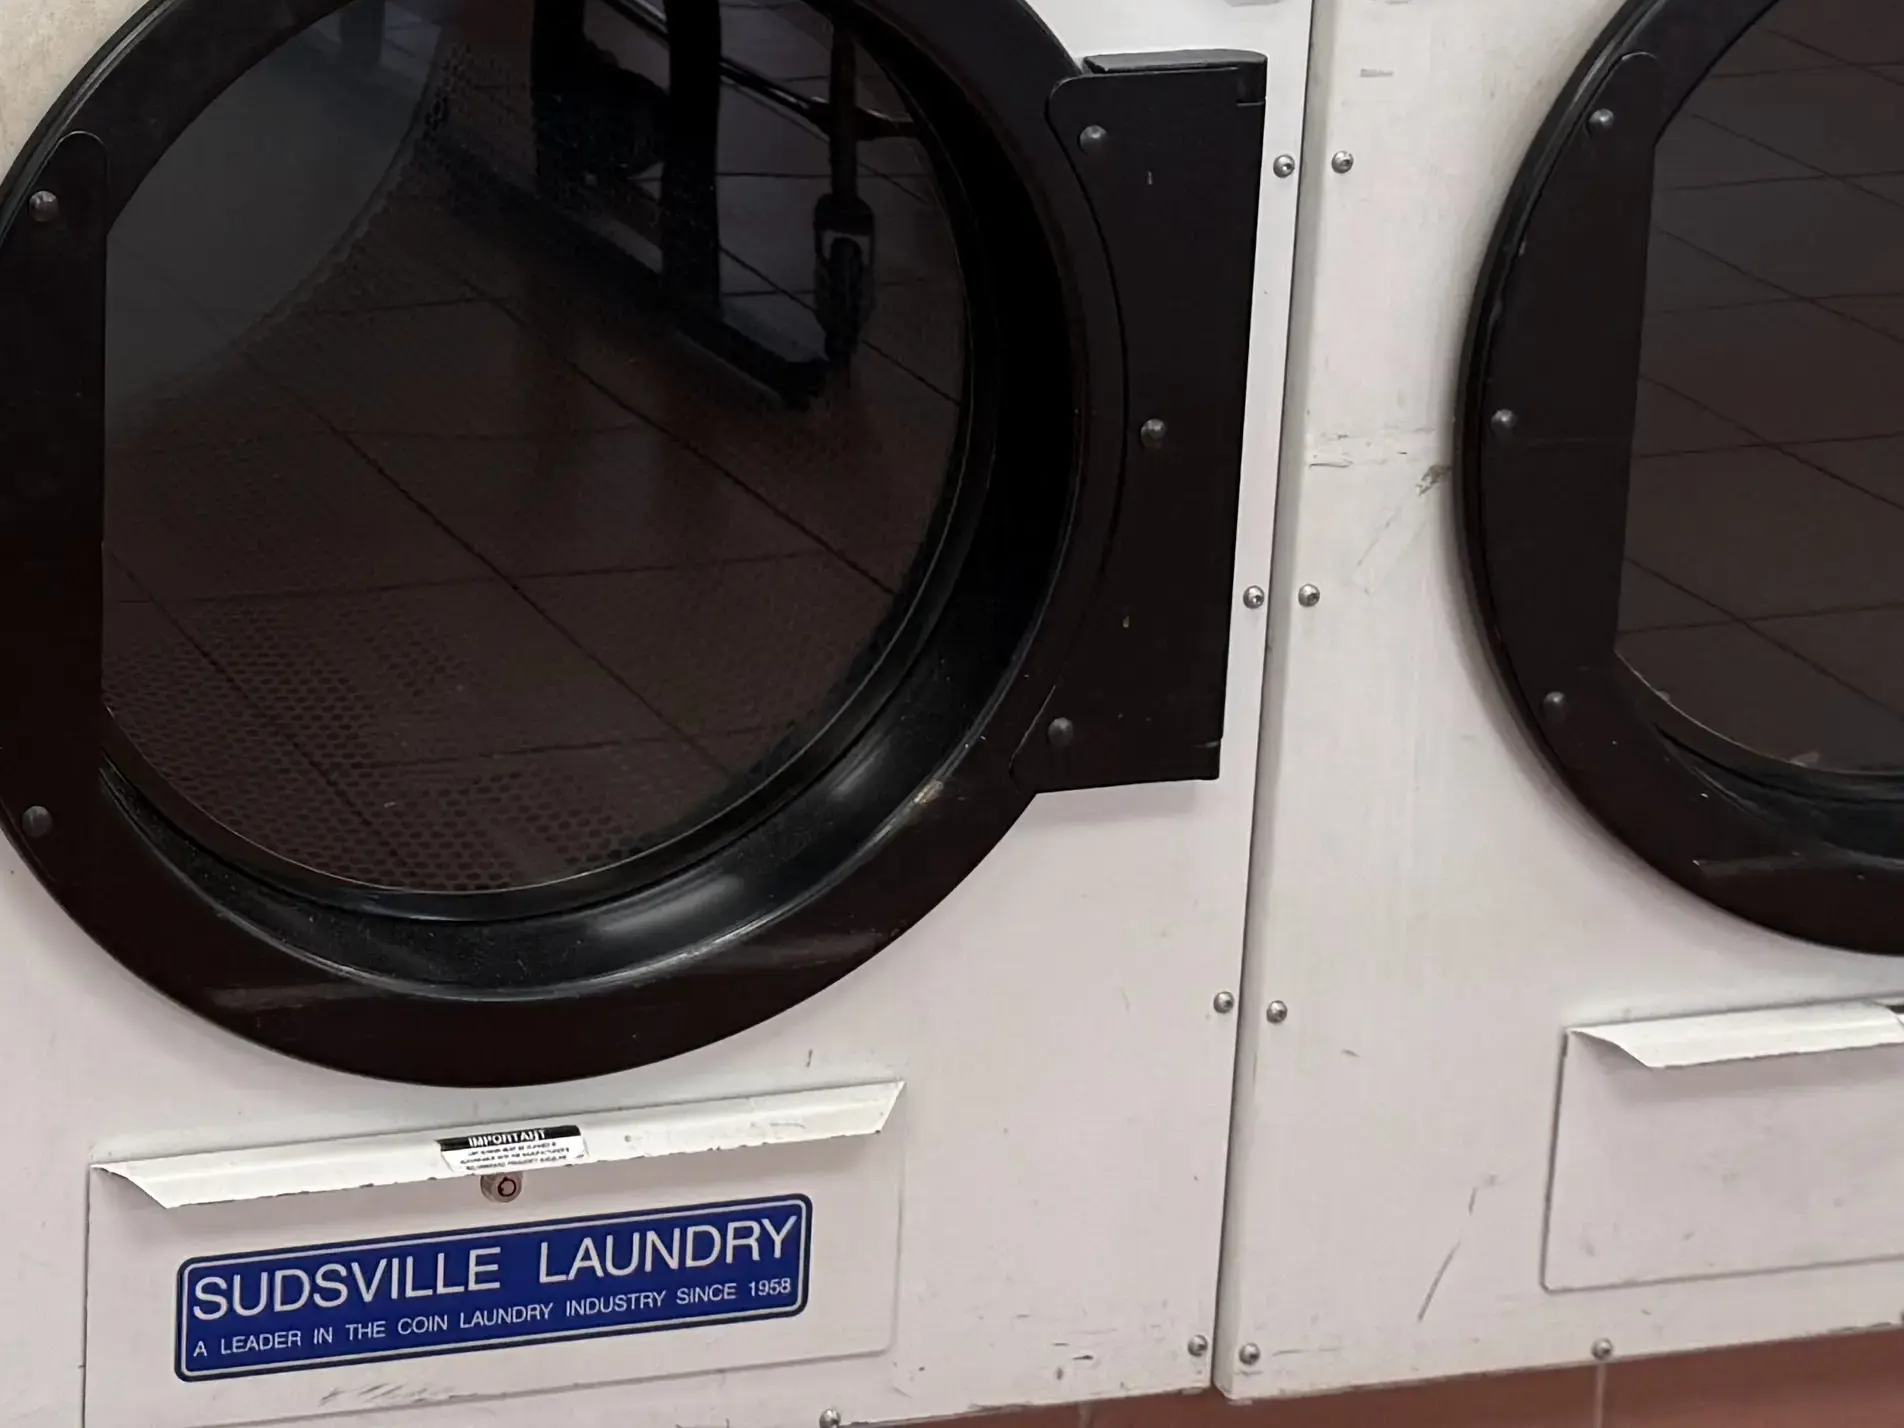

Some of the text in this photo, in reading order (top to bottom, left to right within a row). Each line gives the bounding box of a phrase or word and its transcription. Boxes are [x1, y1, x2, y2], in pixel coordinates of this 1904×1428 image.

[193, 1215, 798, 1322] SUDSVILLE LAUNDRY
[193, 1277, 791, 1357] A LEADER IN THE COIN LAUNDRY INDUSTRY SINCE 1958
